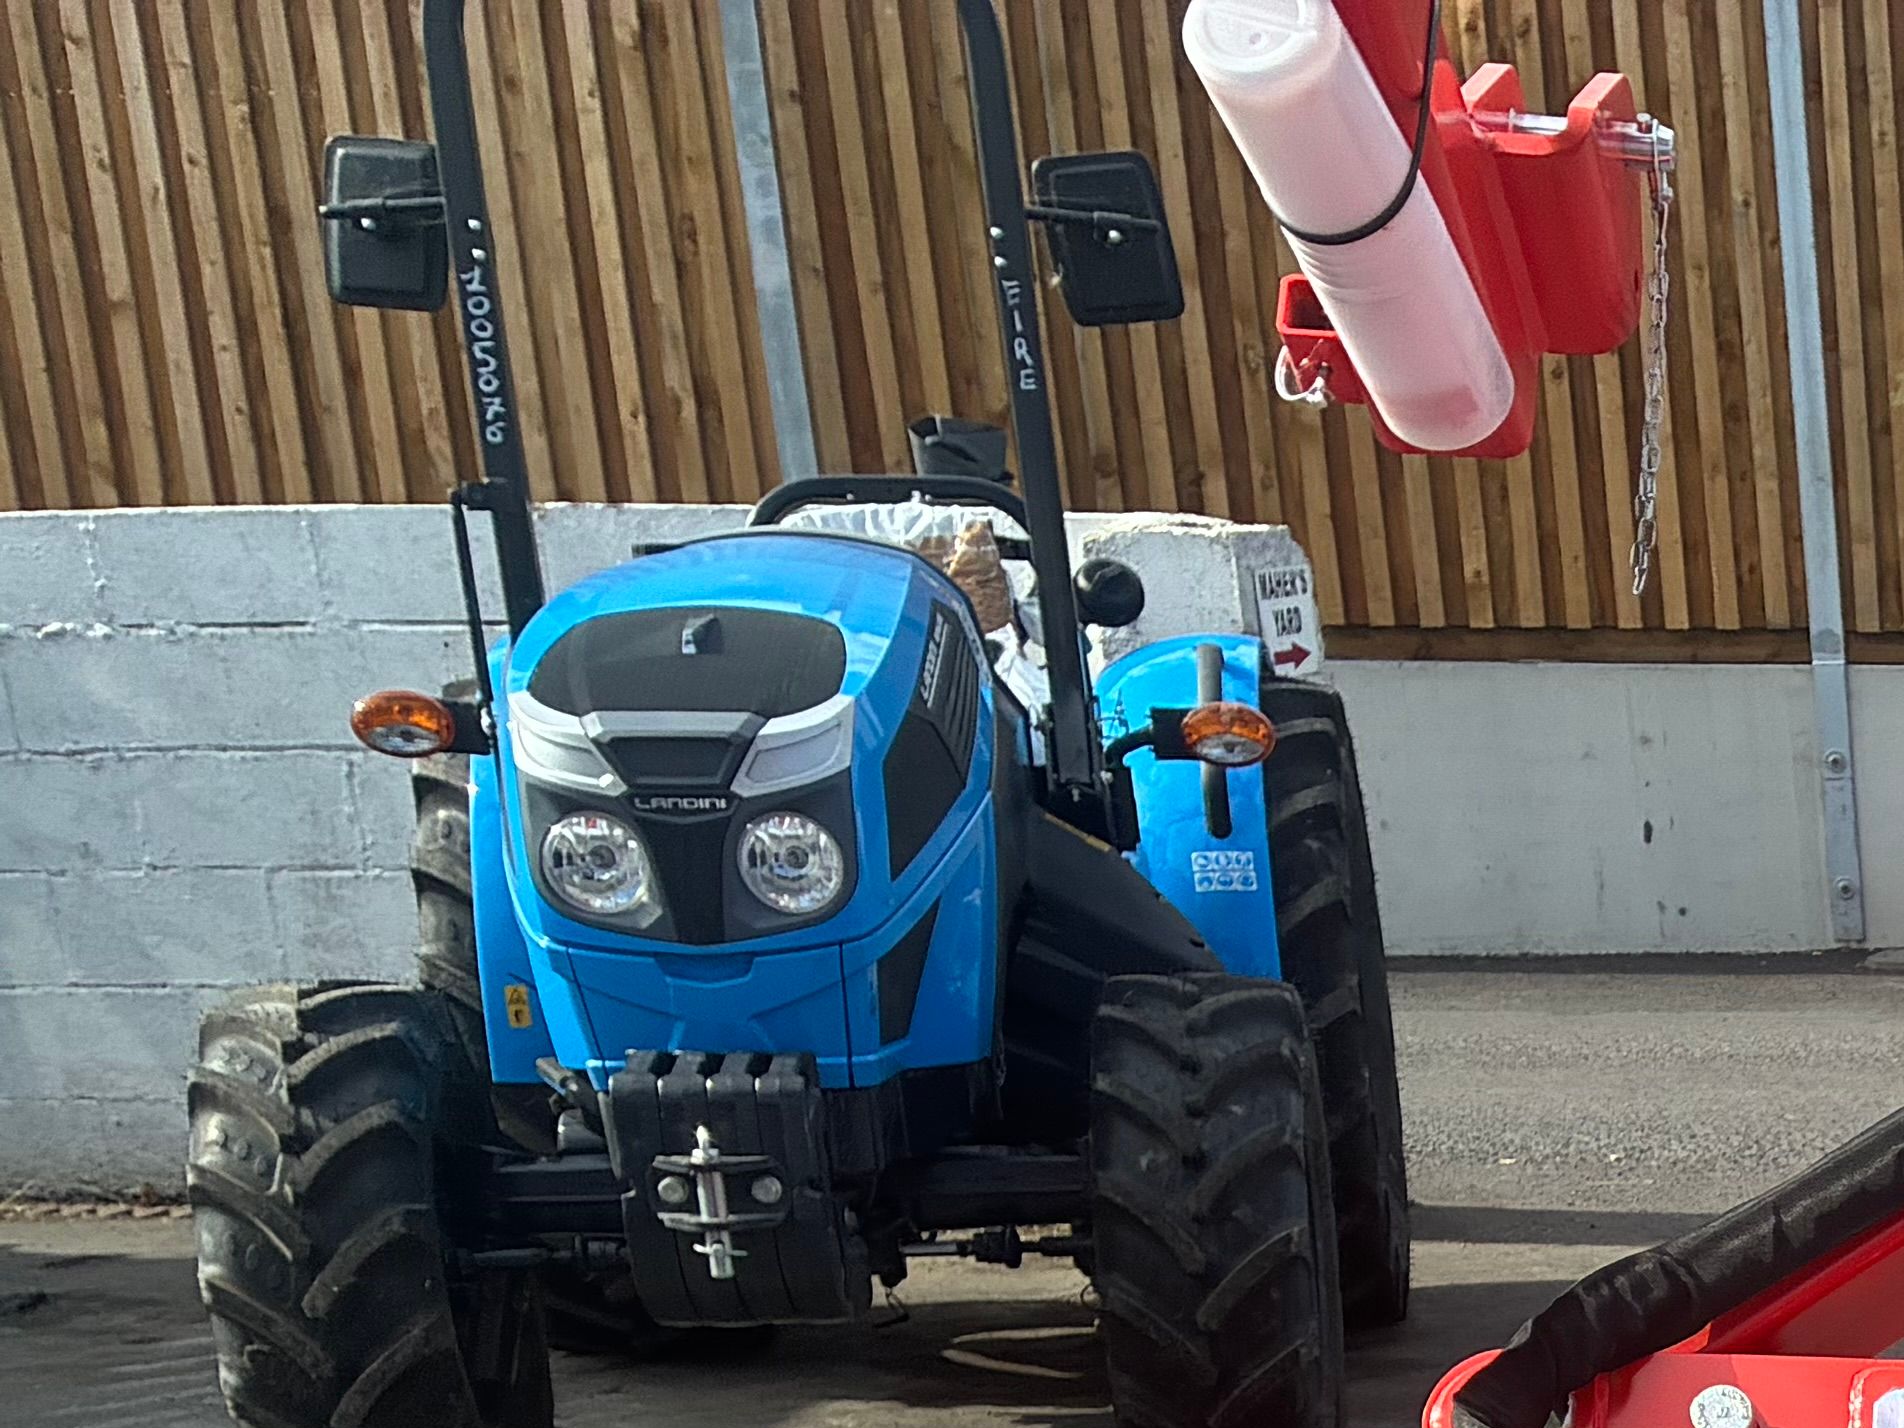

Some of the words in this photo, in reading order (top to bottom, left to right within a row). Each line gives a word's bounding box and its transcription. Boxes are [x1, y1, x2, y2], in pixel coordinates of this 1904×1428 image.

[1001, 278, 1037, 390] EIRE
[1272, 606, 1302, 637] YARD
[633, 797, 727, 809] LANDINI
